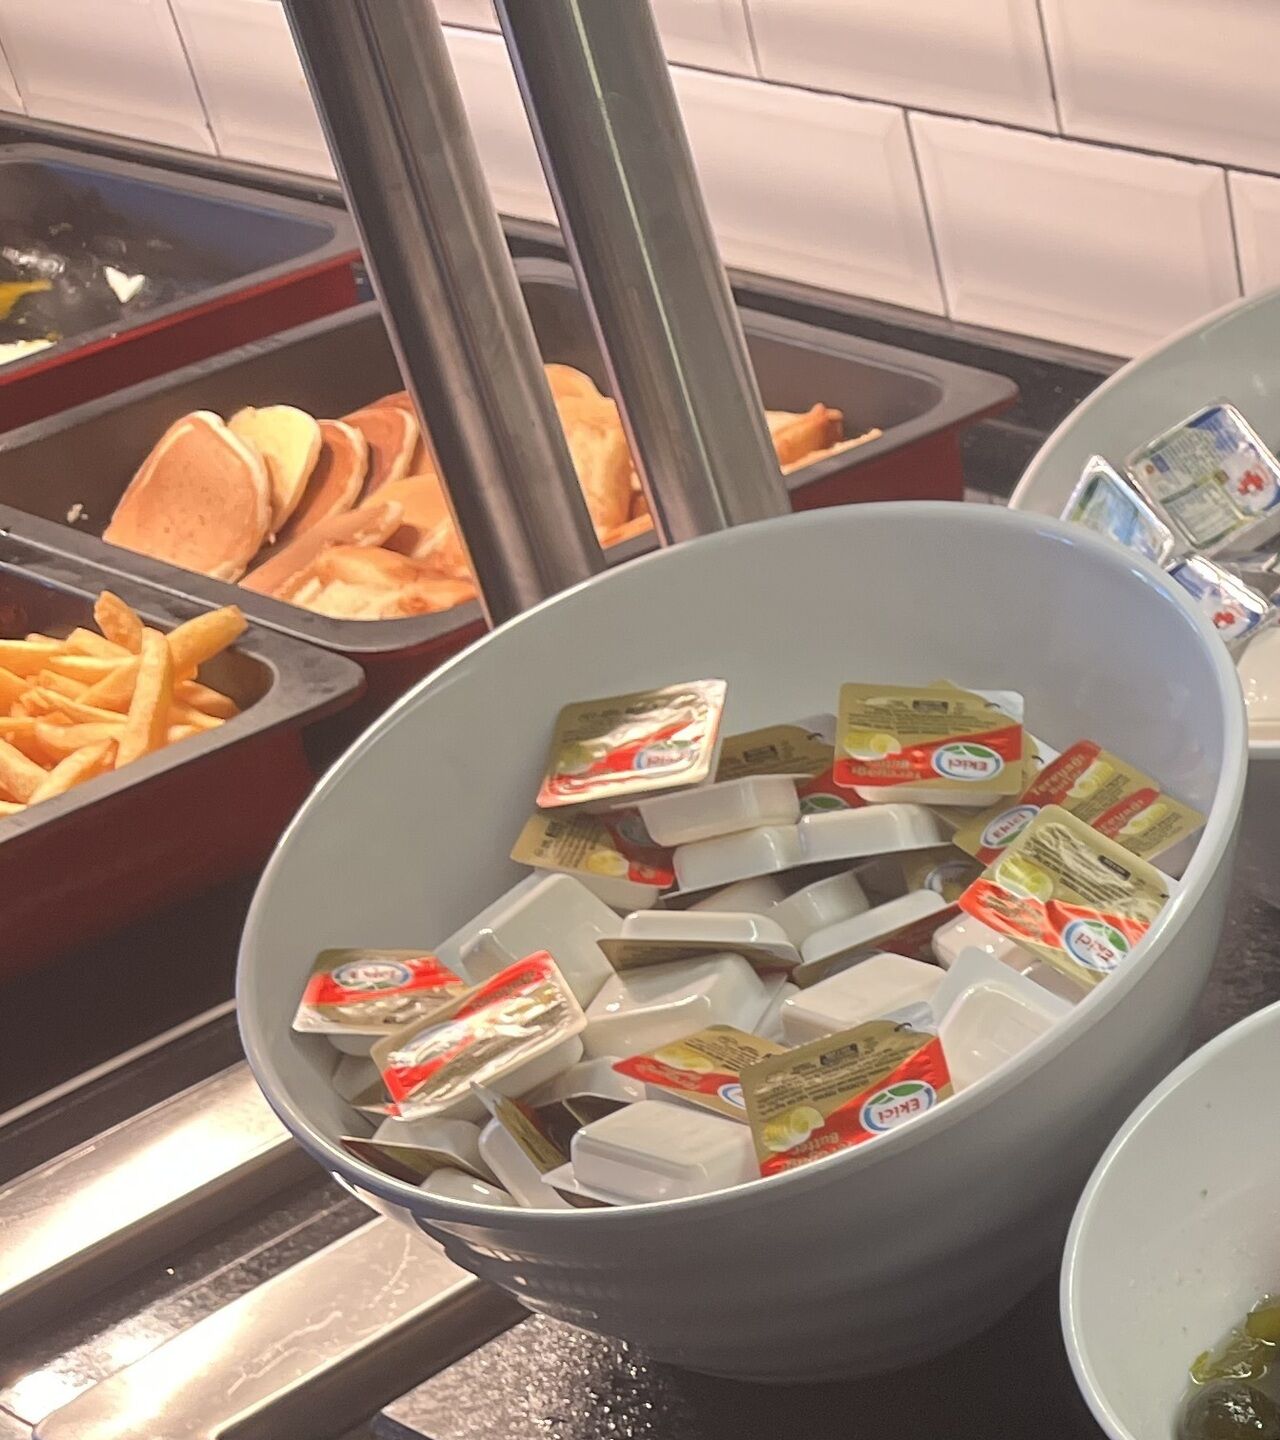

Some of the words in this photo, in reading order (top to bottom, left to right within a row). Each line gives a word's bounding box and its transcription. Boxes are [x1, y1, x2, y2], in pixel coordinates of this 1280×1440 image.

[948, 757, 989, 772] Ekici
[991, 811, 1029, 840] Ekici
[1074, 931, 1117, 964] Ekici
[877, 1097, 922, 1125] Ekici
